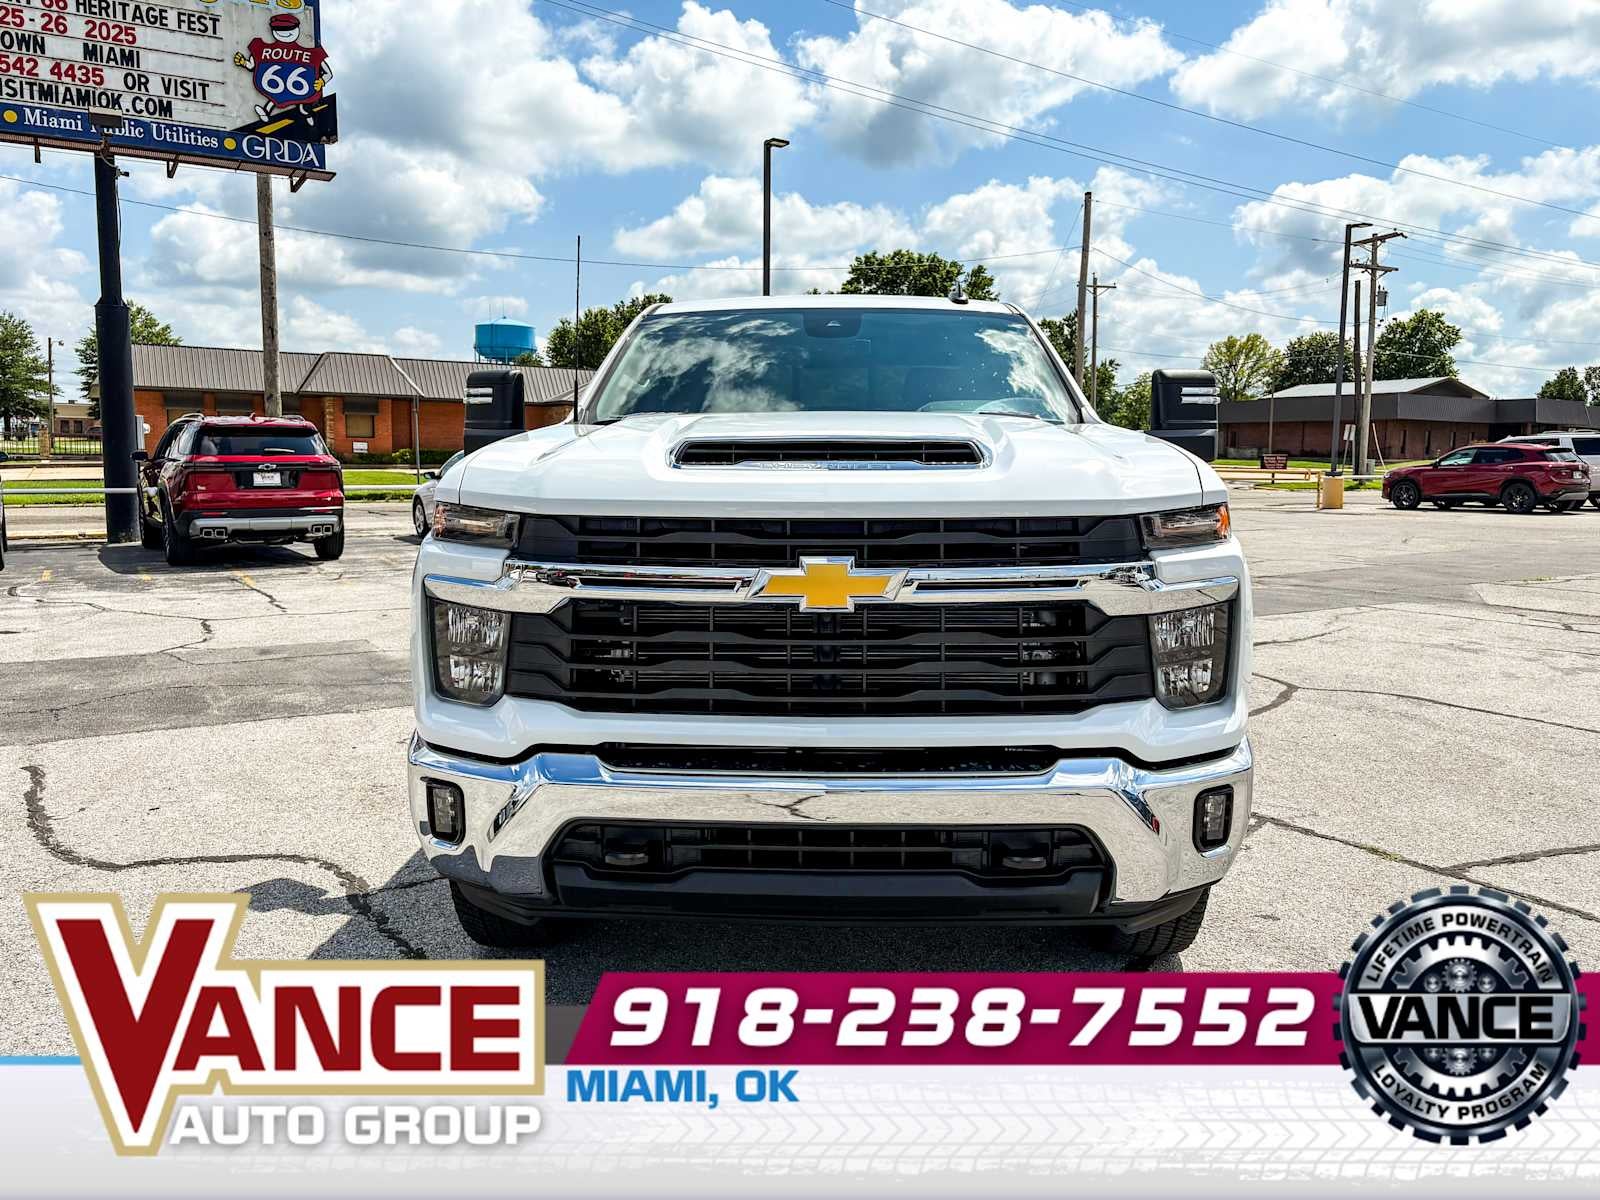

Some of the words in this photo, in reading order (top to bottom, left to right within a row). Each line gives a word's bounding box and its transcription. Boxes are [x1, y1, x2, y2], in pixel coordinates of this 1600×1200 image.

[75, 0, 169, 31] HERITAGE
[177, 13, 221, 36] FEST
[84, 19, 137, 45] 2025
[0, 30, 46, 55] OWN
[83, 42, 141, 69] MIAMI
[261, 48, 312, 63] ROUTE
[0, 53, 39, 77] 542
[50, 61, 105, 87] 4435
[123, 72, 150, 93] OR
[160, 76, 210, 101] VISIT
[261, 64, 310, 96] 66
[23, 107, 83, 131] Miami
[150, 121, 219, 149] Utilities
[242, 134, 320, 167] GRDA
